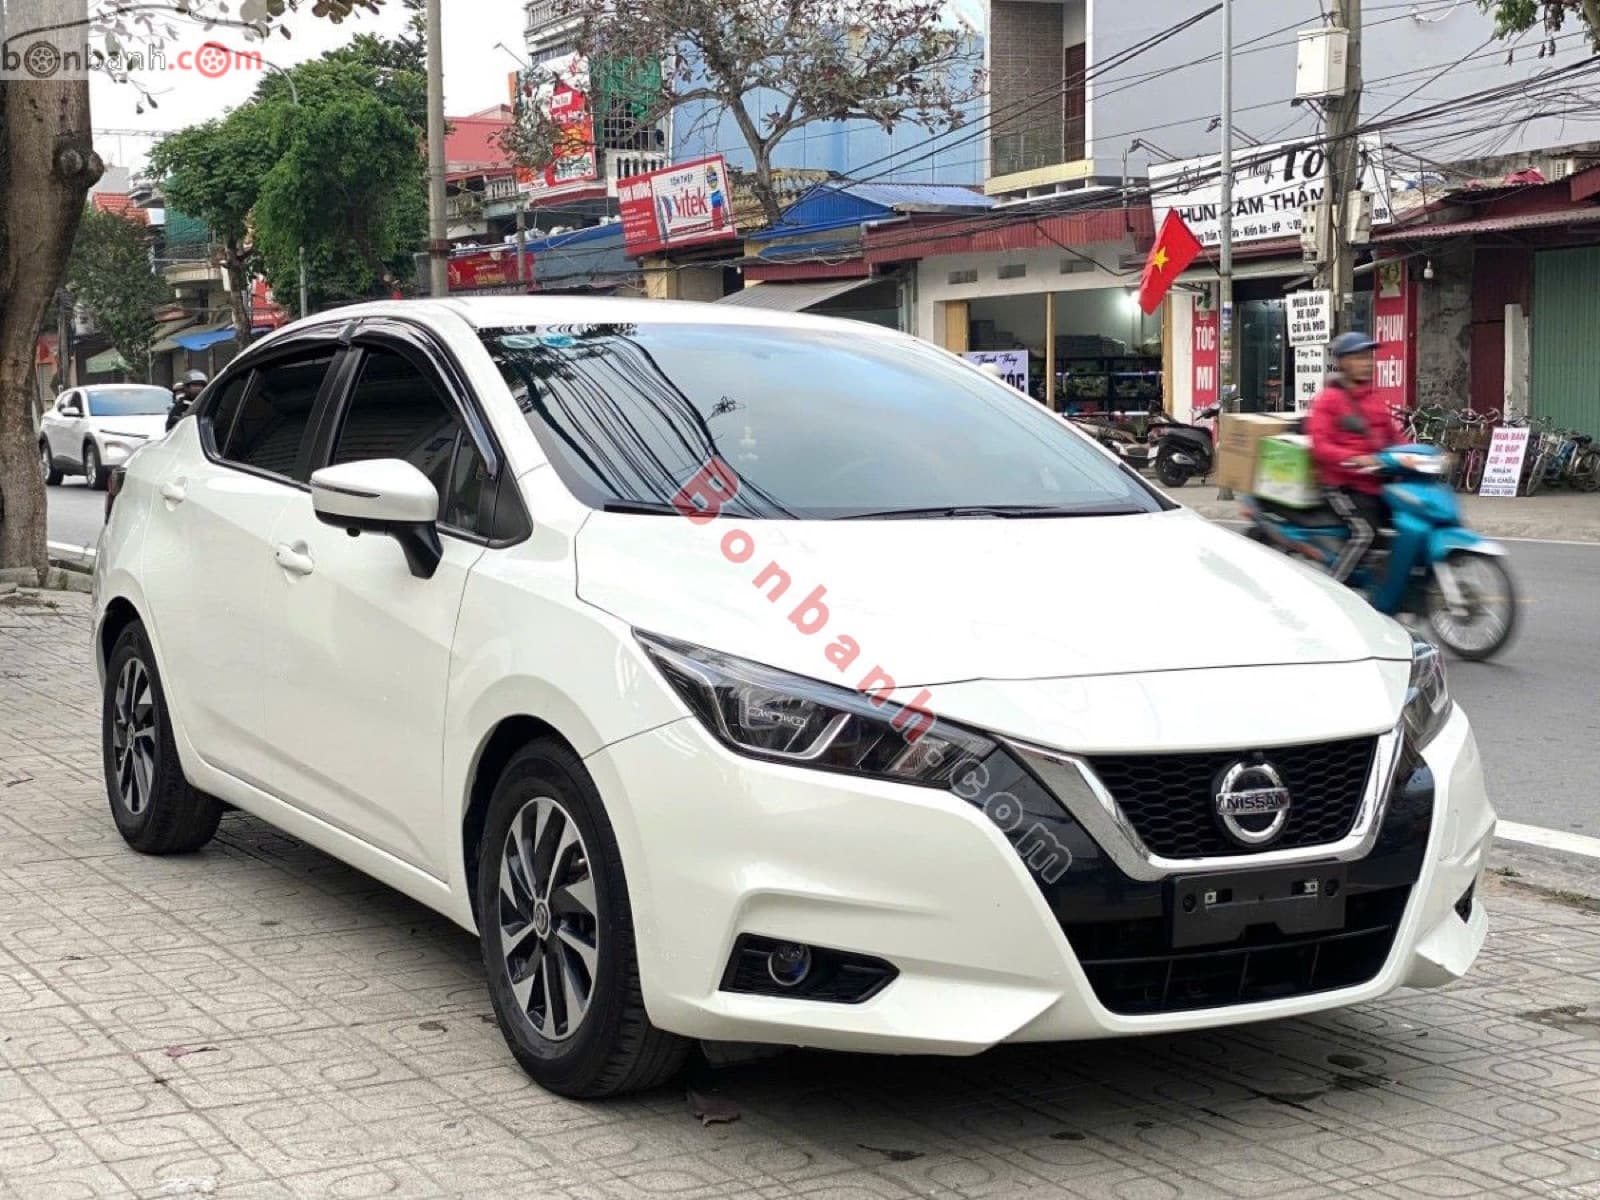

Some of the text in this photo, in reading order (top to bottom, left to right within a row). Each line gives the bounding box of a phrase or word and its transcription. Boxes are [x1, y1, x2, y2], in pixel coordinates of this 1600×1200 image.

[1177, 203, 1217, 223] HUN
[1292, 297, 1308, 308] MUA
[1296, 308, 1305, 320] XE
[1195, 320, 1216, 352] TÓC
[1376, 314, 1404, 343] PHUN
[999, 369, 1026, 393] ÓC
[1195, 366, 1214, 391] MI
[1376, 355, 1404, 388] THÊU
[1225, 792, 1281, 810] NISSAN
